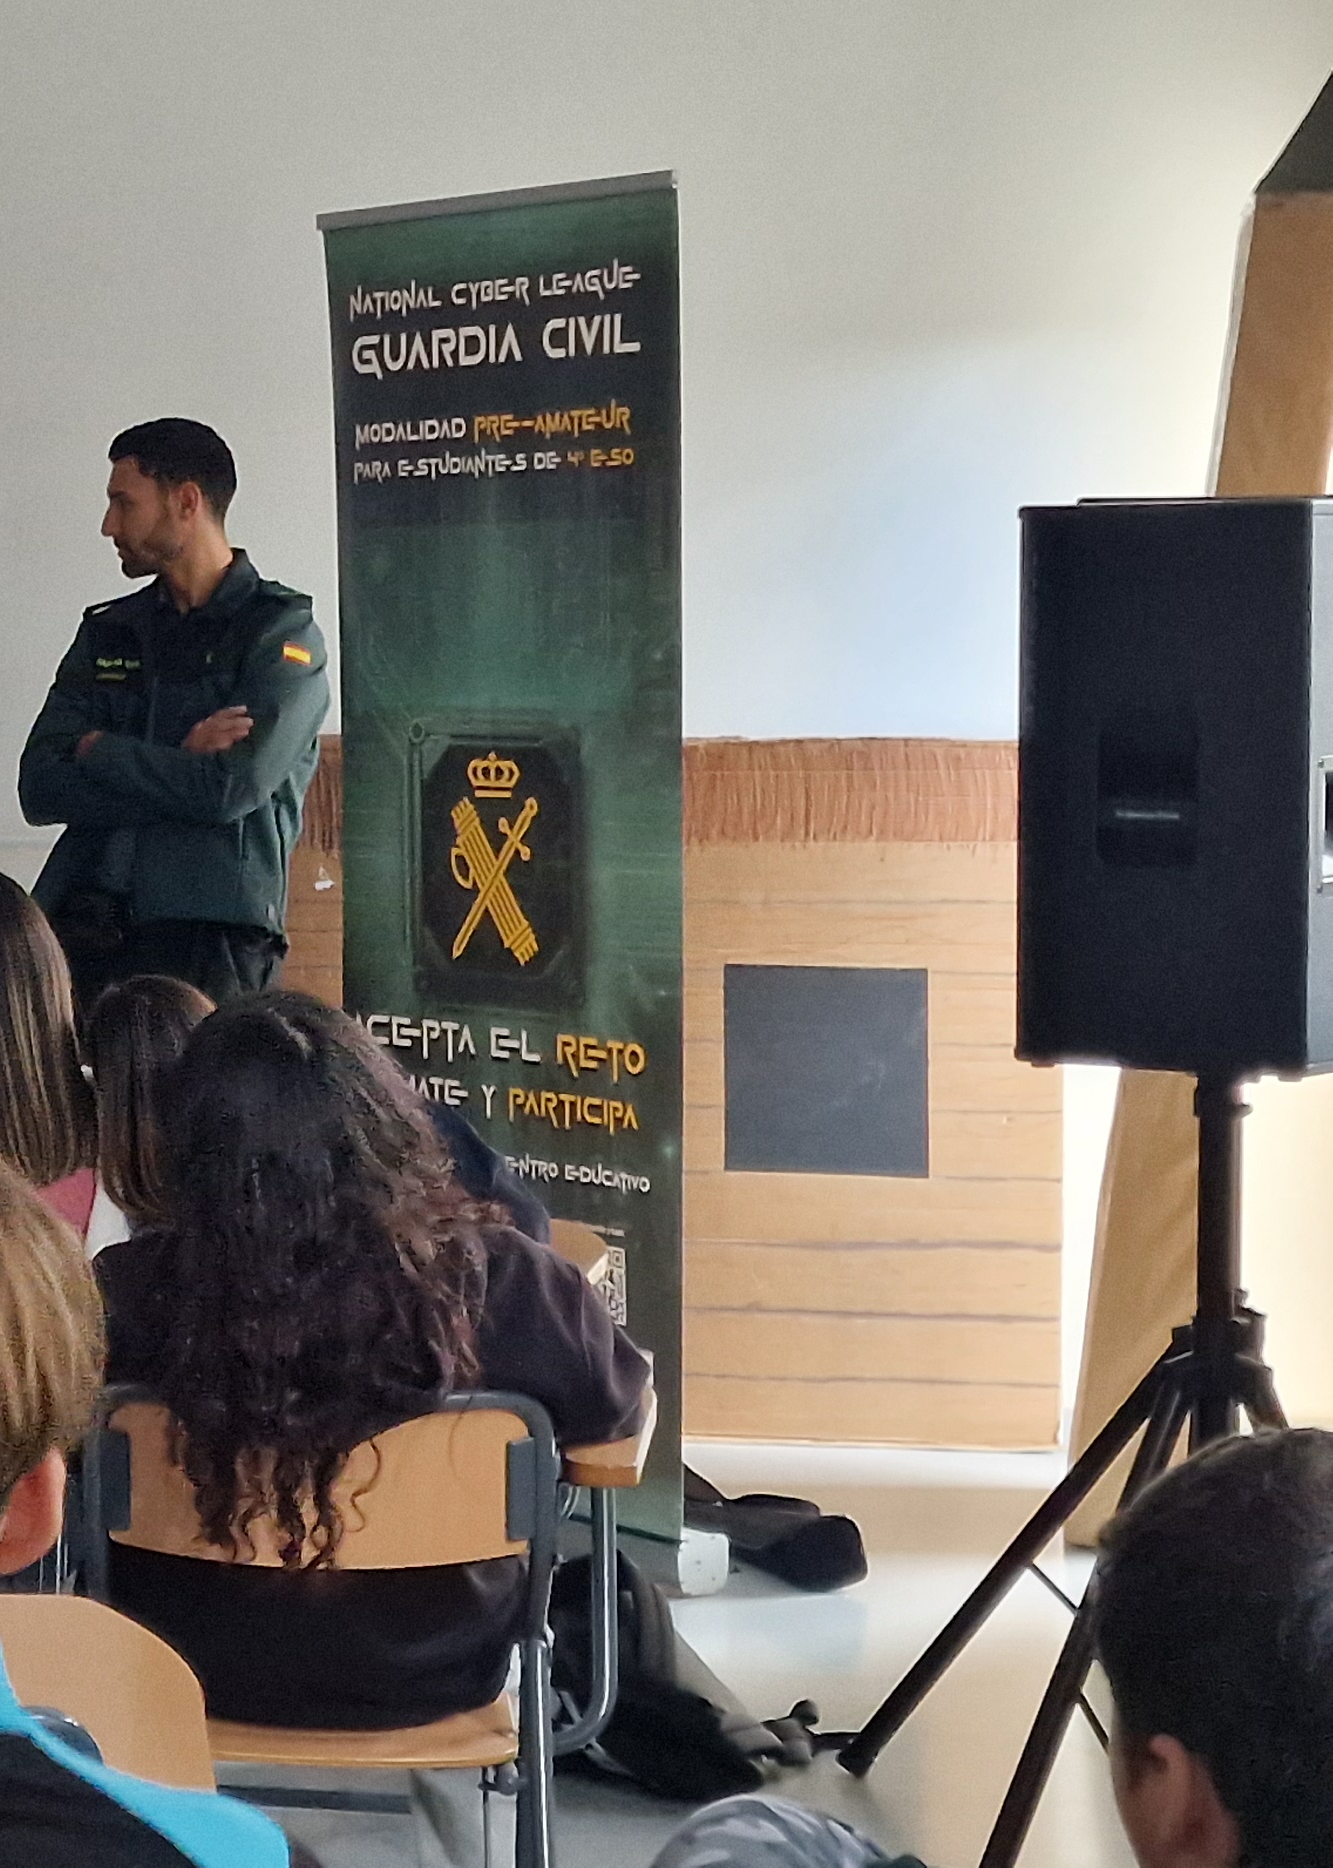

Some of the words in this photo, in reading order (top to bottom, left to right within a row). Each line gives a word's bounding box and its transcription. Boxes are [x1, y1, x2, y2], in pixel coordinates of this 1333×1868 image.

[349, 279, 442, 322] NATIONAL
[451, 276, 530, 310] CYBER
[539, 258, 641, 300] LEAGUE
[352, 322, 523, 380] GUARDIA
[542, 313, 641, 359] CIVIL
[355, 417, 467, 450] MODALIDAD
[354, 460, 392, 484] PARA
[397, 448, 527, 481] ESTUDIANTES
[533, 451, 562, 470] DE
[590, 448, 634, 467] ESO
[490, 1026, 542, 1063] EL
[556, 1033, 646, 1084] RETO
[481, 1084, 497, 1120] Y
[508, 1087, 639, 1136] PARTICIPA
[504, 1153, 559, 1183] ENTRO
[564, 1163, 651, 1195] EDUCATIVO
